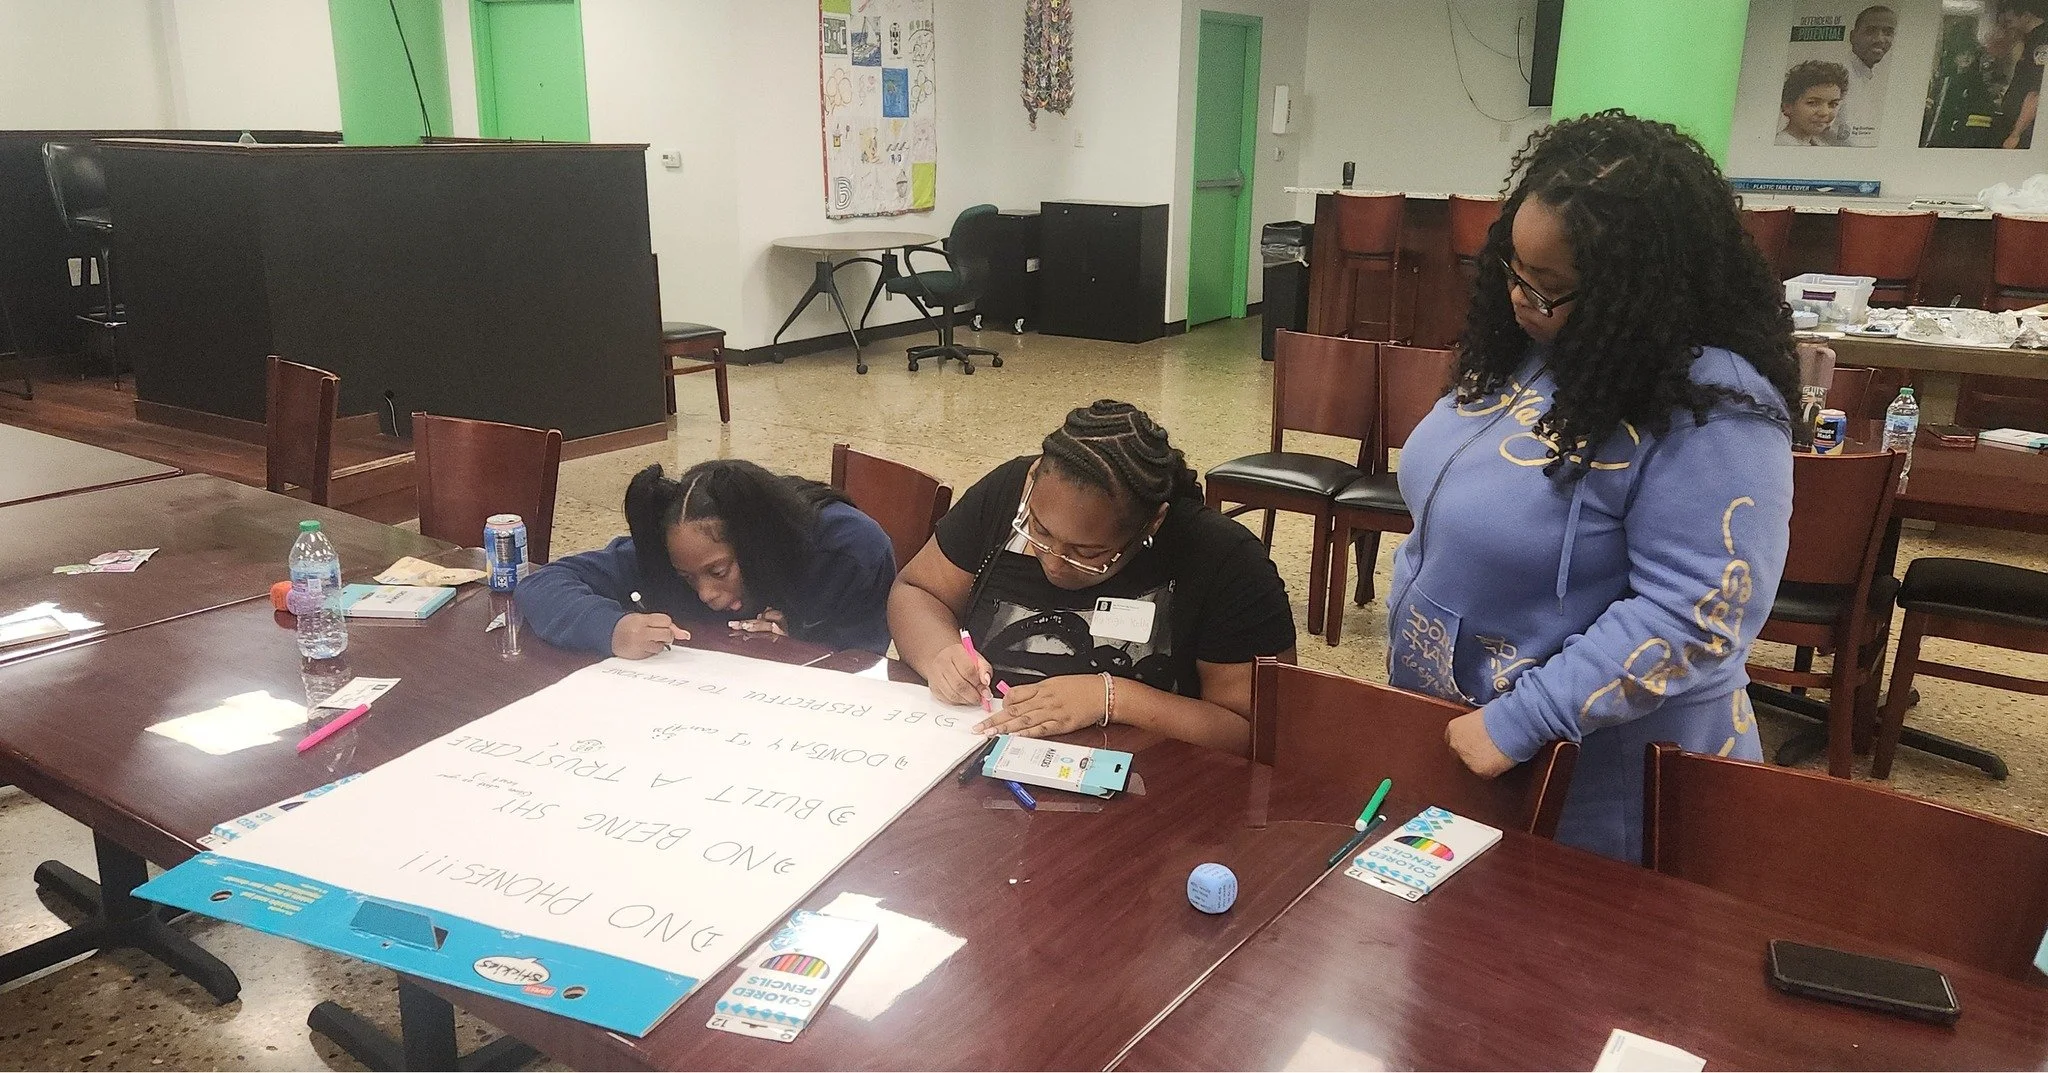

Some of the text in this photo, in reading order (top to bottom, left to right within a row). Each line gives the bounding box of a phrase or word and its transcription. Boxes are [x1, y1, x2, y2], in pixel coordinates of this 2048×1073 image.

[697, 684, 727, 696] TO
[740, 690, 872, 718] RESPECTFUL
[882, 708, 927, 724] BE
[515, 753, 627, 785] TRUST
[650, 771, 692, 790] A
[493, 798, 560, 822] SHY
[706, 784, 824, 821] BUILT
[584, 808, 691, 851] BEING
[703, 840, 779, 872] NO
[1368, 850, 1437, 878] COLORED
[1381, 845, 1441, 870] PENCILS
[399, 849, 594, 916] PHONES!!!
[1348, 869, 1363, 878] 12
[482, 960, 543, 982] Stickies
[731, 986, 813, 1009] COLORED
[745, 975, 818, 996] PENCILS
[710, 1017, 730, 1027] 12
